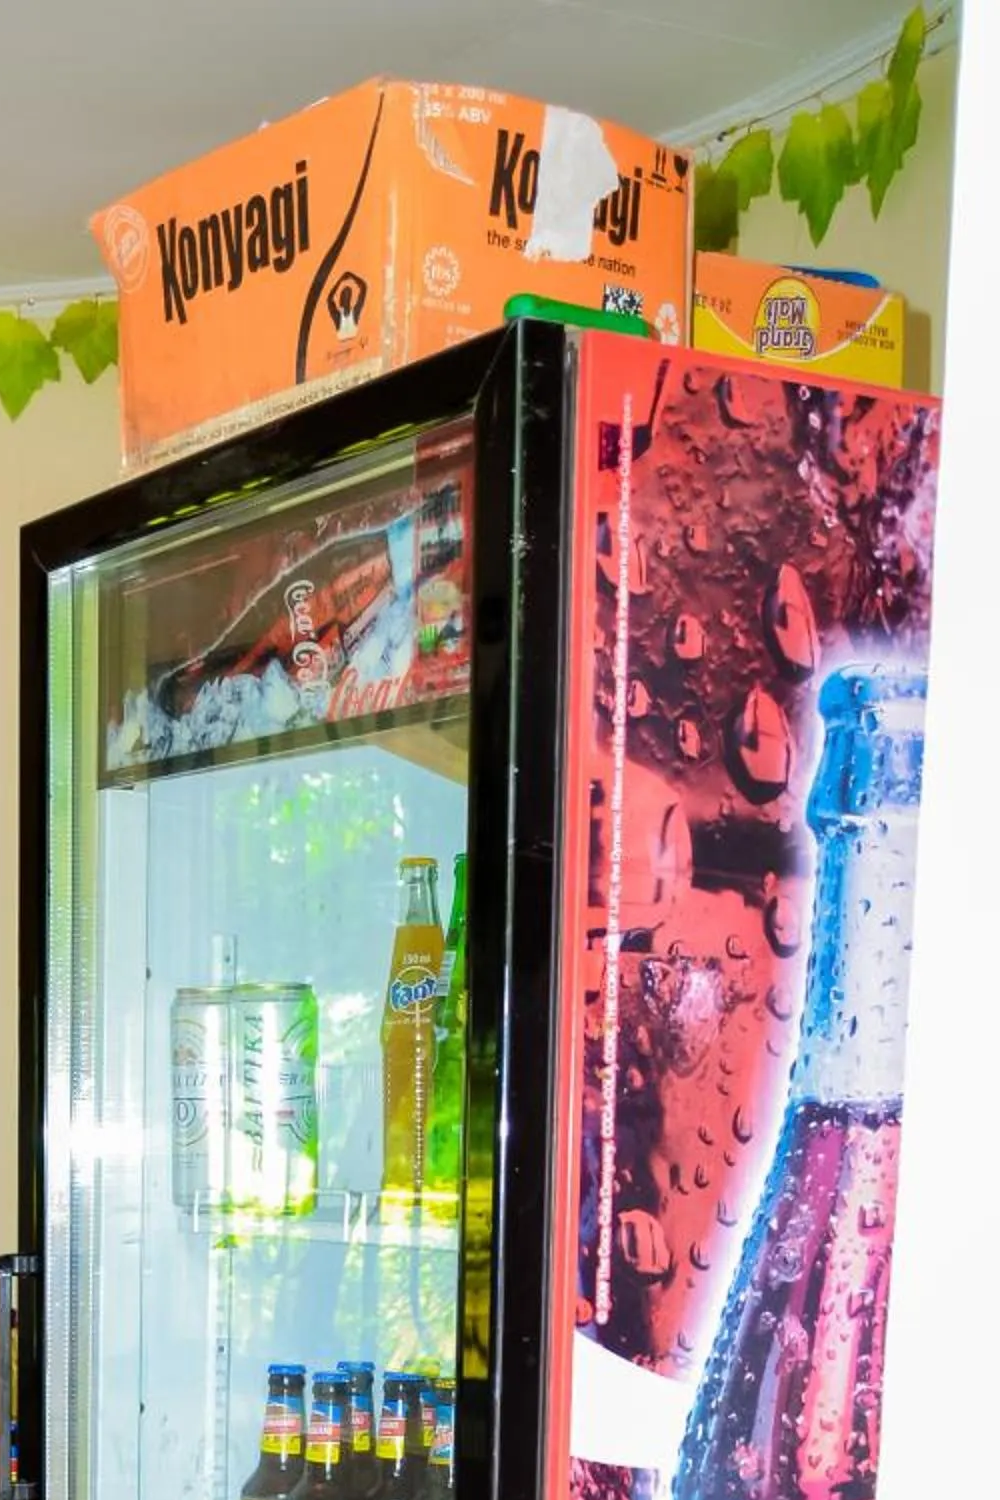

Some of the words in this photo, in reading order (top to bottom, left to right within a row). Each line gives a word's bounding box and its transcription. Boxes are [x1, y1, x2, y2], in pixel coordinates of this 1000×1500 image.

[459, 104, 491, 125] ABV
[157, 159, 309, 325] Konyagi
[487, 229, 511, 249] the
[598, 253, 636, 278] nation
[765, 298, 806, 325] Malt
[757, 327, 816, 356] Grand
